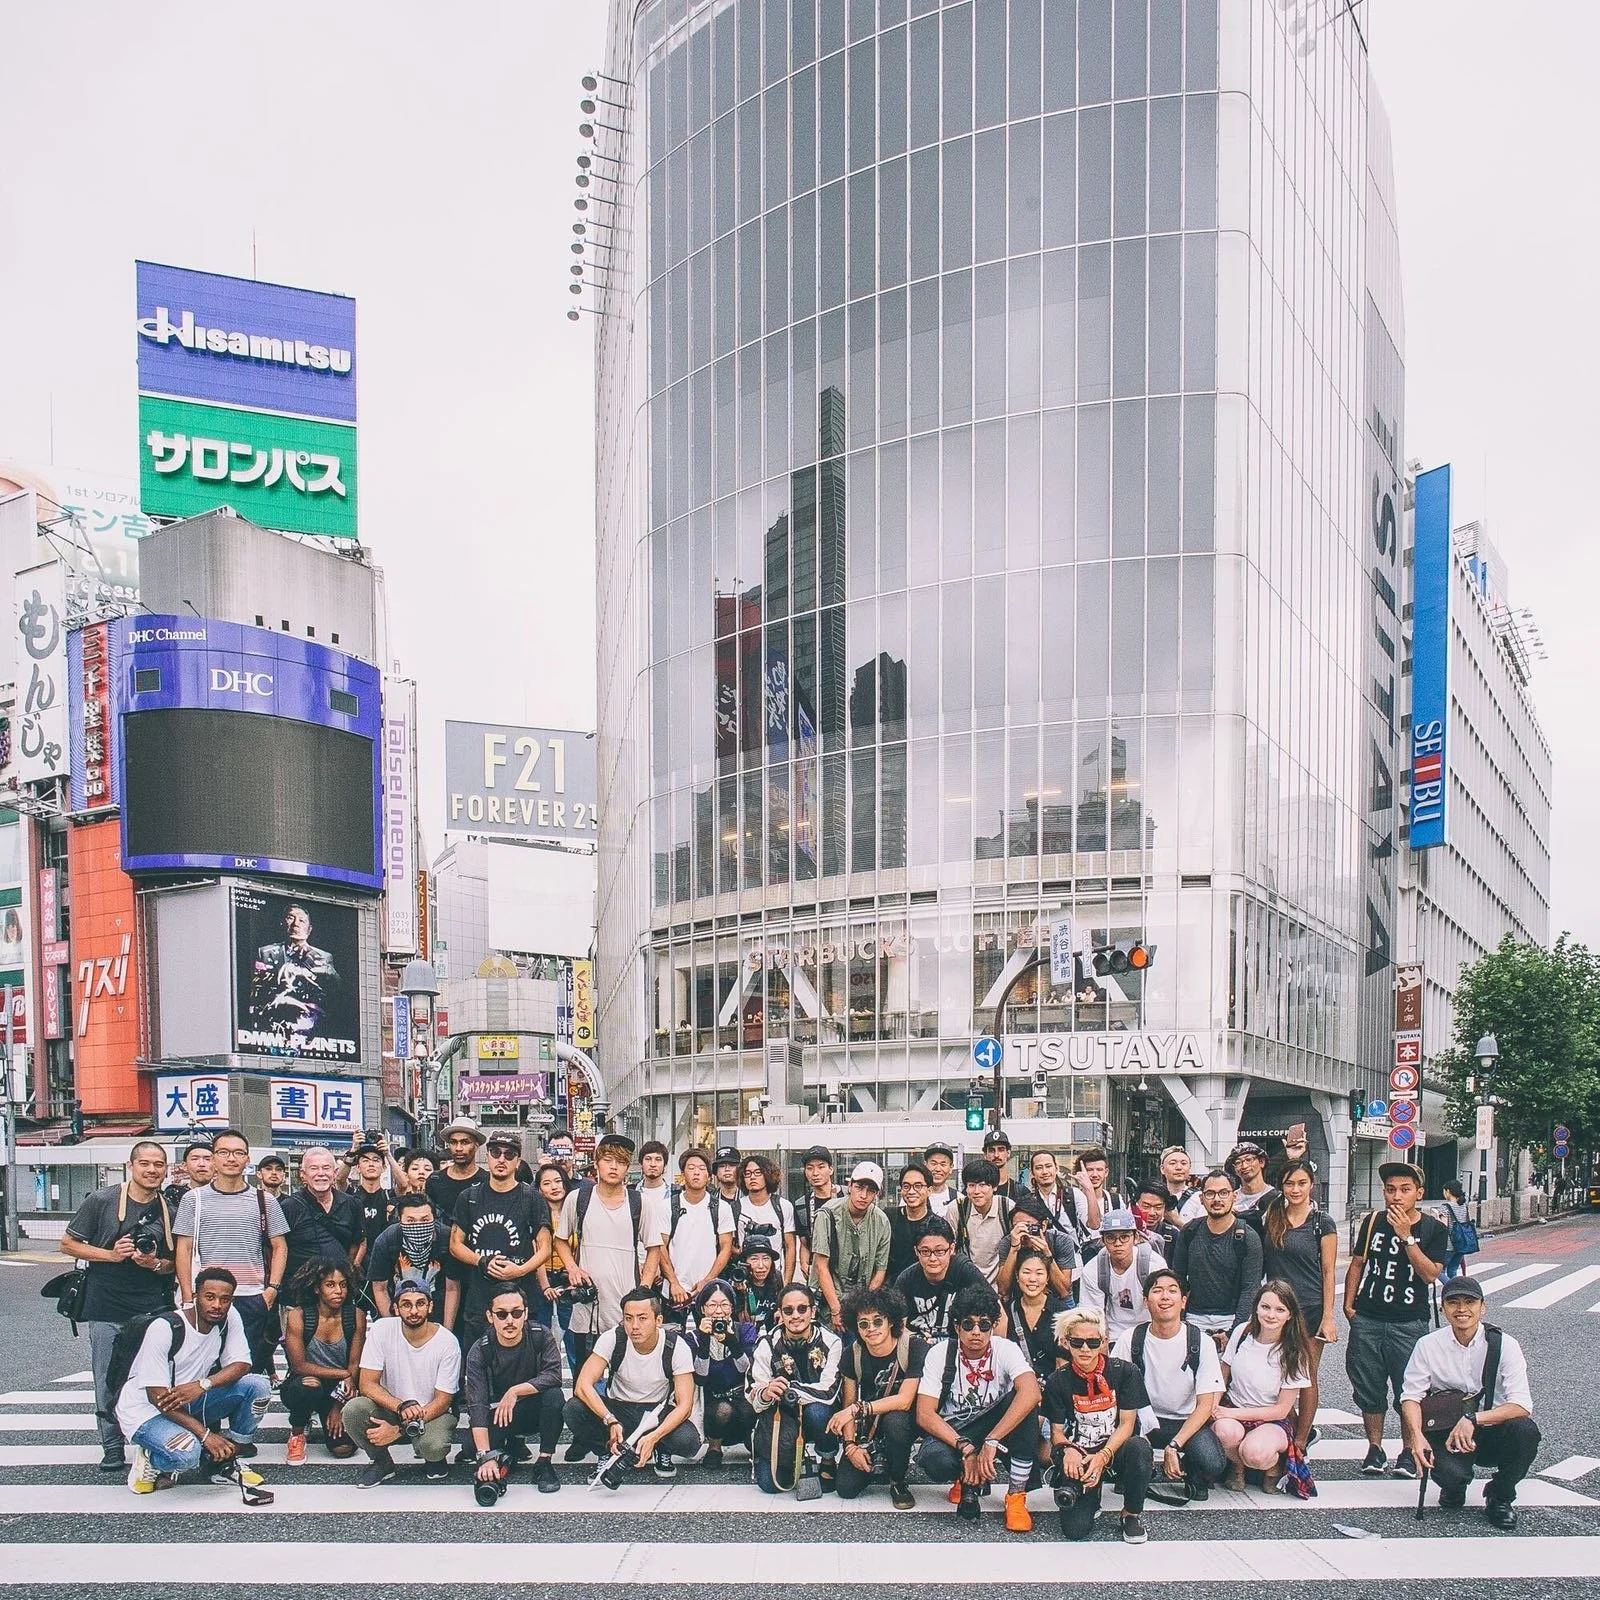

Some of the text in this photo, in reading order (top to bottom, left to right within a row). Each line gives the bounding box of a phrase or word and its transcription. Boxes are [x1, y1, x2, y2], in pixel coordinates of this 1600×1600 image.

[136, 306, 351, 372] Hisamitsu
[147, 429, 346, 496] サロンパス
[66, 487, 89, 497] 1st
[129, 629, 207, 644] DHC Channel
[19, 587, 63, 770] もんじゃ
[210, 668, 274, 696] DHC
[484, 733, 566, 794] F21
[452, 793, 567, 828] FOREVER
[235, 858, 258, 868] DHC
[390, 809, 405, 880] neon
[748, 935, 918, 973] STARBUCKS
[1059, 924, 1071, 978] 渋谷駅前
[78, 932, 131, 1037] クスリ
[578, 1028, 590, 1037] 4F
[1012, 1034, 1204, 1072] TSUTAYA
[1400, 1044, 1417, 1061] 本
[166, 1083, 352, 1121] 大盛 書店
[504, 1219, 520, 1246] RATS
